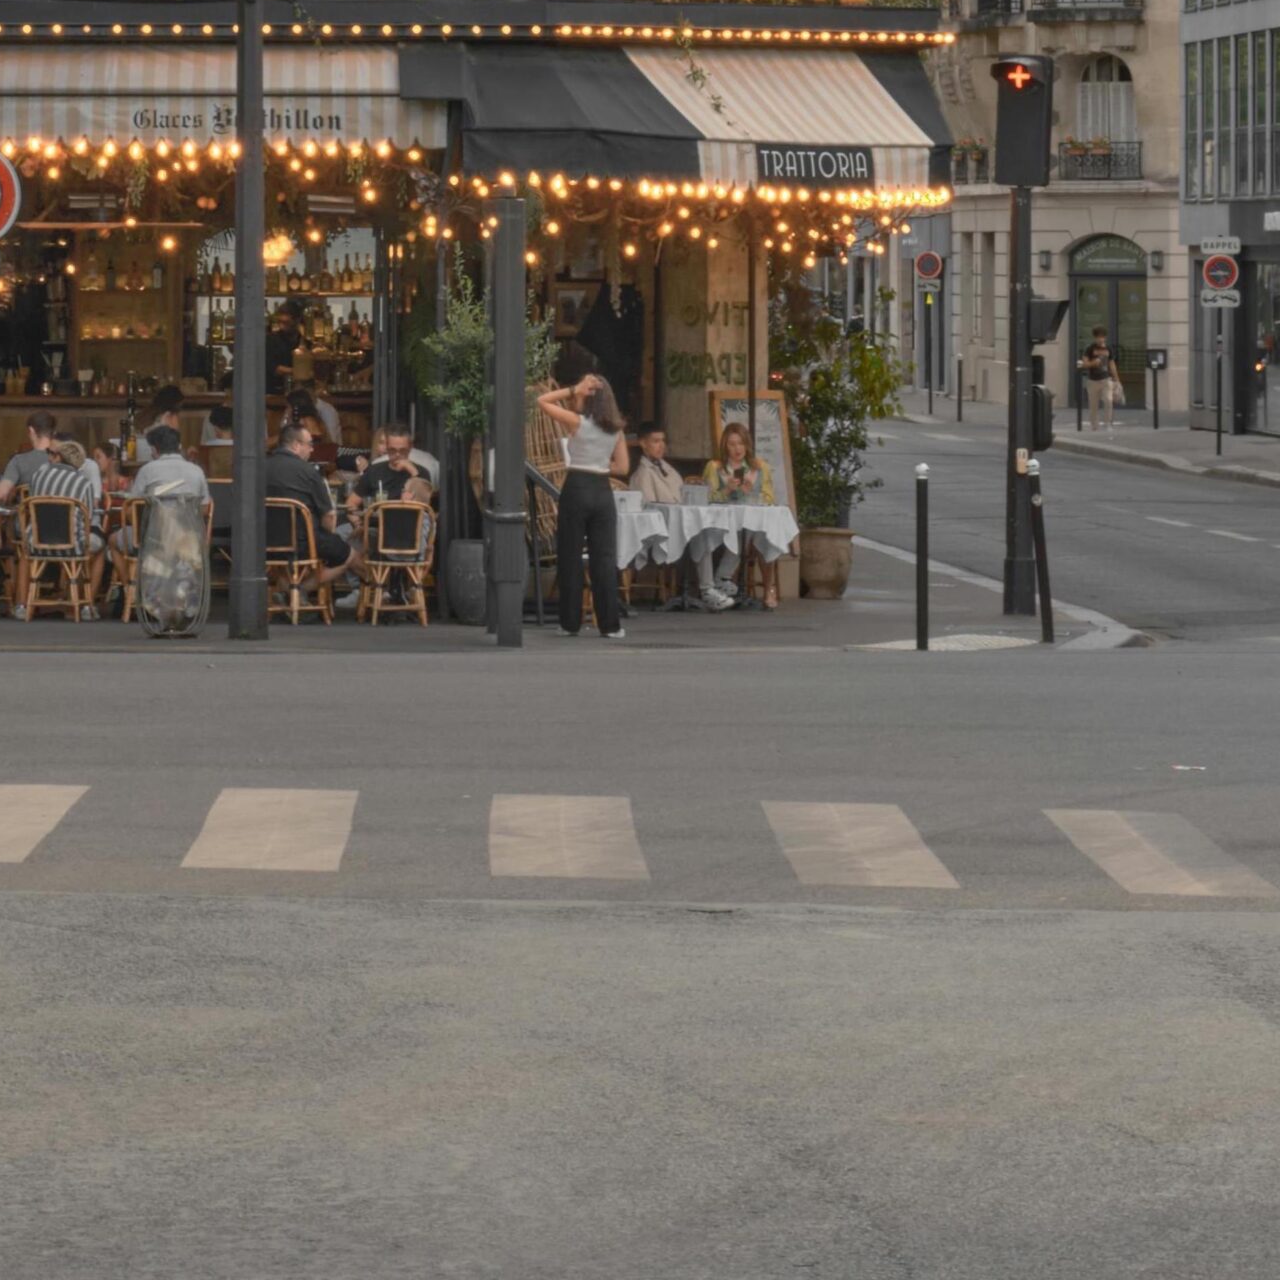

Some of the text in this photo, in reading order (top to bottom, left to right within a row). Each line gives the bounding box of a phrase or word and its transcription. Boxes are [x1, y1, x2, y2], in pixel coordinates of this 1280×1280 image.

[133, 108, 203, 130] Glaces
[760, 149, 869, 179] TRATTORIA
[1203, 240, 1238, 250] RAPPEL
